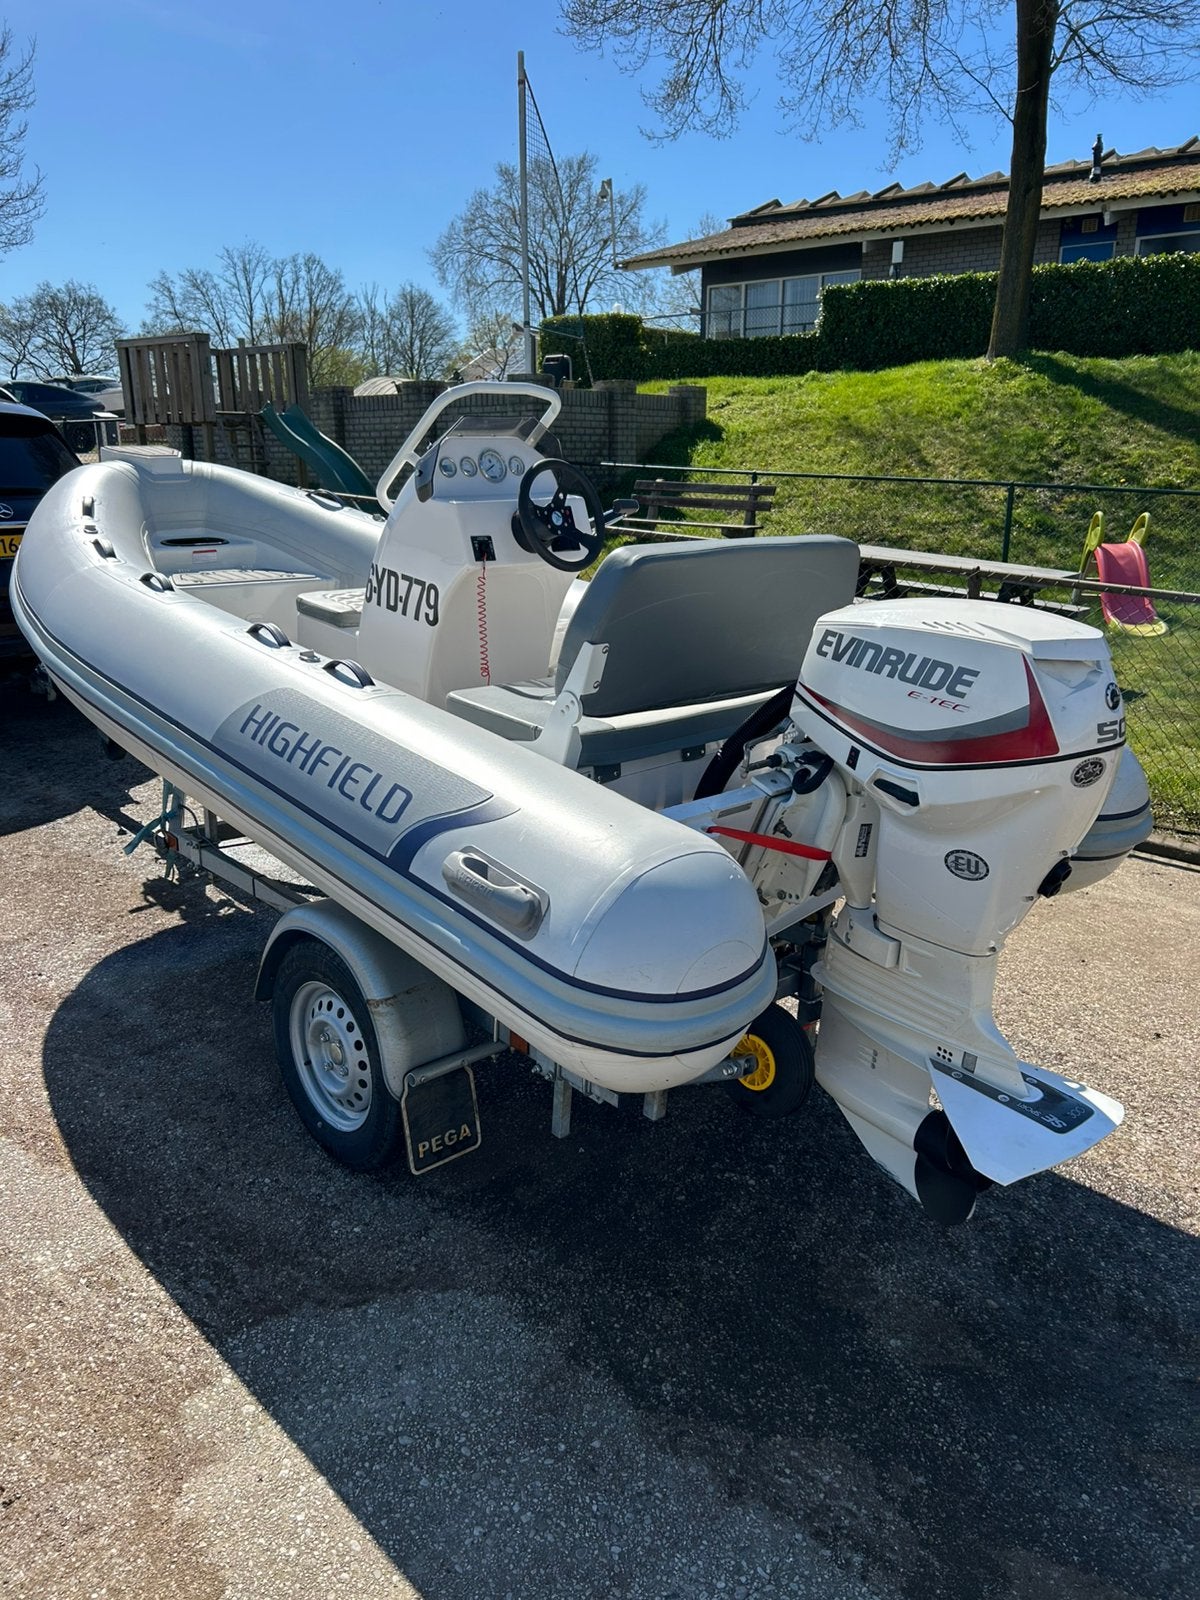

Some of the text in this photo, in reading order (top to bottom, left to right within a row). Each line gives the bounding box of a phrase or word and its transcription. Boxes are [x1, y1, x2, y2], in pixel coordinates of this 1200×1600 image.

[816, 629, 981, 699] EVINRUDE
[907, 690, 970, 713] E-TEC
[239, 704, 413, 824] HIGHFIELD
[418, 1123, 472, 1158] PEGA
